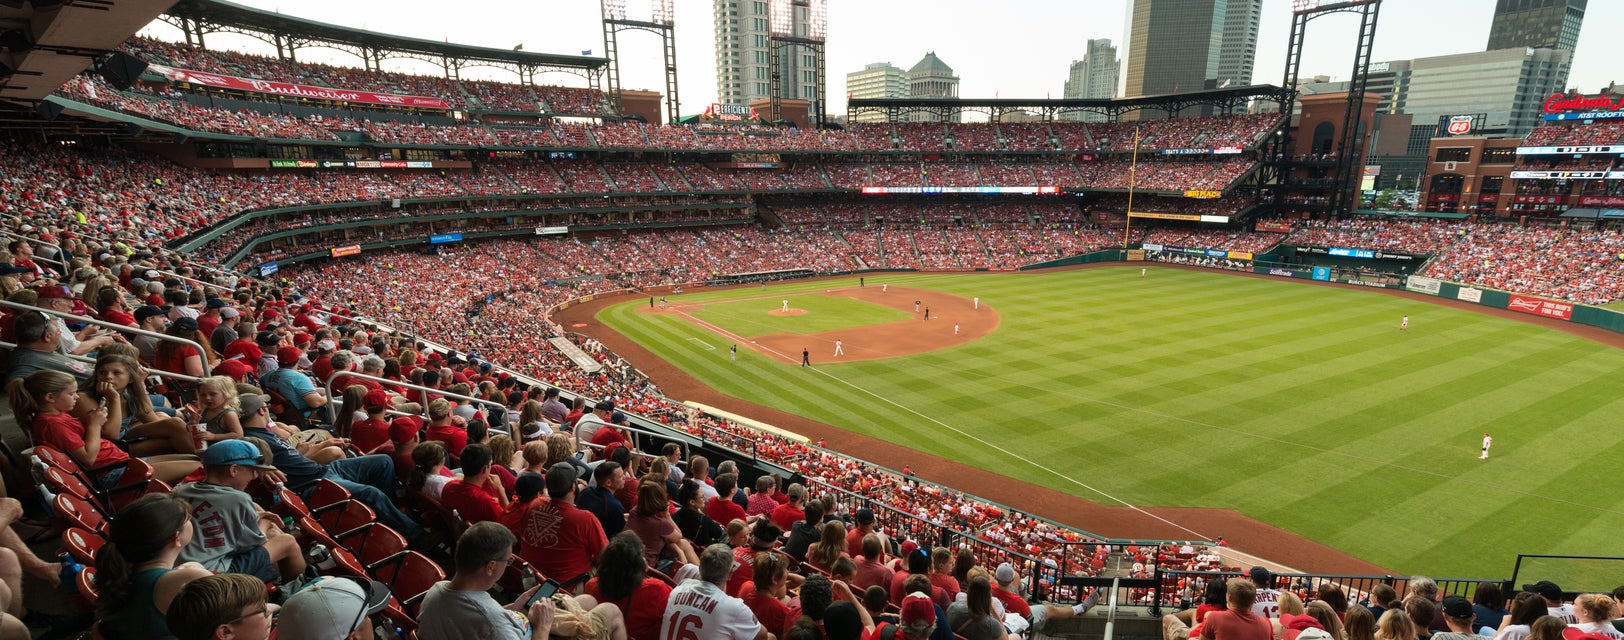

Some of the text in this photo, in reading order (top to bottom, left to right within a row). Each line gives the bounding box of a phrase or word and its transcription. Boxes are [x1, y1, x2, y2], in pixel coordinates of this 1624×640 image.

[248, 79, 359, 101] Budweiser
[1543, 93, 1611, 113] Cardinals
[1451, 123, 1467, 131] 66
[1200, 190, 1216, 198] MAC
[1555, 302, 1571, 311] BUD'S
[674, 592, 718, 614] DUNCAN
[667, 610, 703, 640] 16
